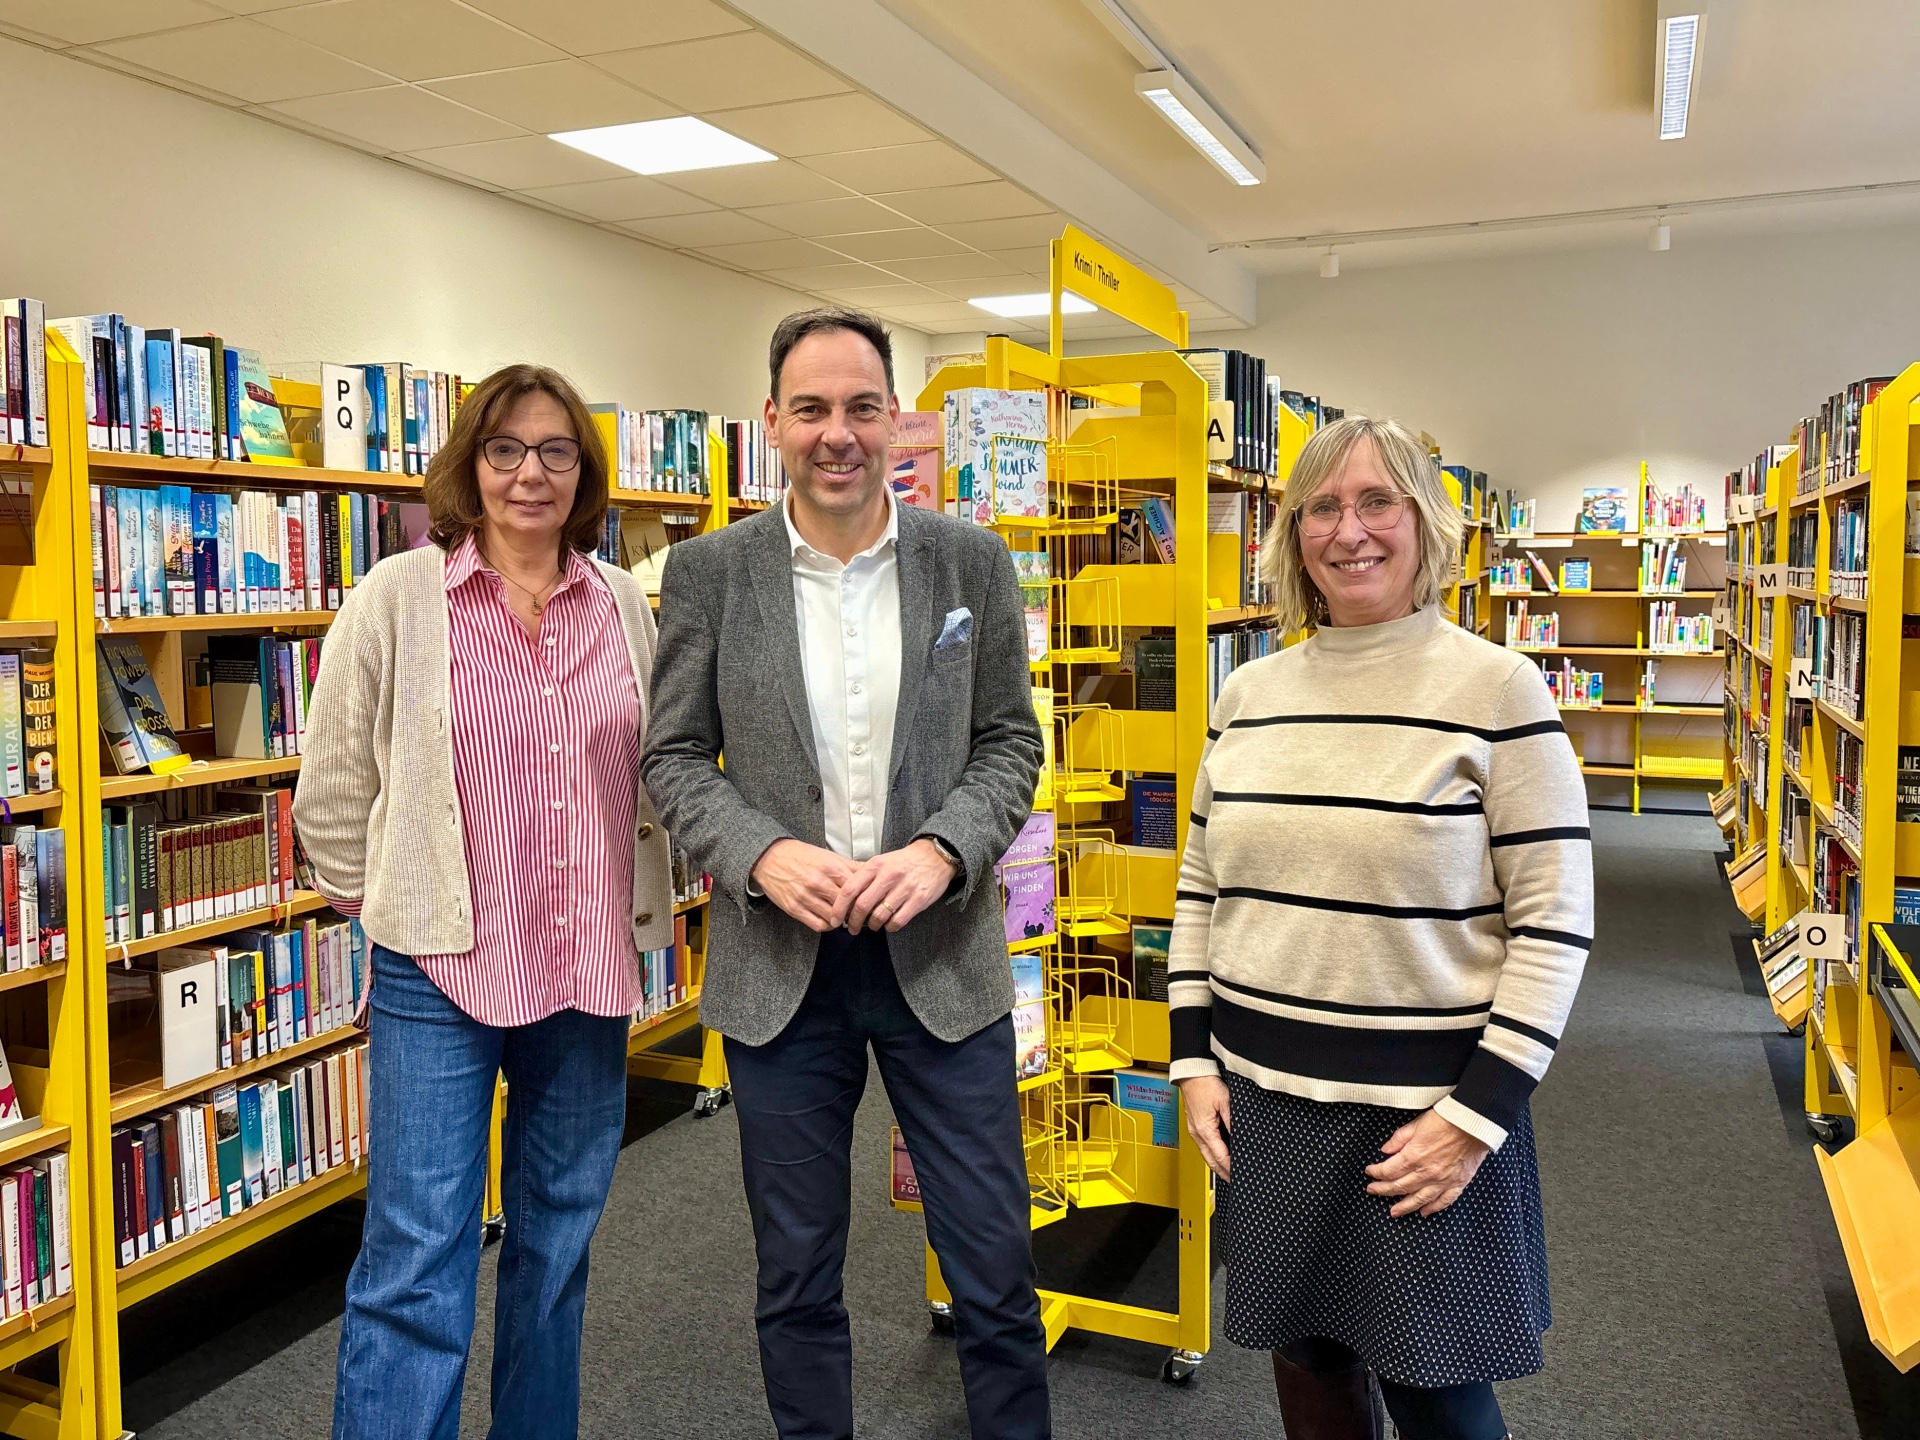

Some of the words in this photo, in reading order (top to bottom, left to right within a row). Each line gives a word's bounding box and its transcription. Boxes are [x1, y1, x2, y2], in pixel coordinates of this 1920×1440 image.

[1074, 251, 1092, 270] Krimi
[1098, 264, 1120, 292] Thriller
[337, 379, 350, 402] P
[240, 419, 270, 430] Schwebe
[336, 406, 353, 430] Q
[906, 420, 928, 431] kleine
[990, 413, 1023, 423] Katharina
[1005, 420, 1028, 432] Herzog
[258, 428, 286, 441] bahnen
[1208, 418, 1226, 442] A
[992, 430, 1040, 454] TRÄUME
[1002, 450, 1014, 458] im
[980, 452, 1040, 476] SOMMER-
[994, 475, 1025, 490] wind
[330, 500, 338, 531] EUROPA
[1738, 504, 1748, 516] L
[1148, 505, 1166, 536] AICHNER
[170, 522, 179, 545] Stille
[128, 546, 137, 569] Pauly
[204, 551, 212, 572] Pauly
[222, 548, 230, 568] Pauly
[1491, 552, 1500, 562] H
[332, 560, 340, 587] GRAND
[1759, 573, 1777, 588] M
[1026, 618, 1044, 626] NUSA
[1716, 612, 1724, 624] J
[105, 644, 143, 660] RICHARD
[114, 664, 150, 678] POWERS
[1798, 669, 1812, 687] N
[32, 682, 51, 699] DER
[26, 698, 55, 715] STICH
[134, 696, 156, 712] DAS
[3, 681, 19, 766] URAKAMI
[34, 716, 52, 731] DER
[135, 714, 172, 734] GROSSE
[29, 730, 56, 748] BIENE
[148, 738, 174, 754] SPIEL
[1903, 756, 1920, 770] NE
[1897, 794, 1920, 804] WUND
[1006, 844, 1038, 856] ORGEN
[140, 862, 148, 890] ANNIE
[1003, 872, 1020, 882] WIR
[1021, 870, 1038, 880] UNS
[1014, 882, 1044, 894] FINDEN
[1894, 906, 1920, 916] WOLF
[1900, 914, 1920, 924] TAL
[1806, 926, 1827, 946] O
[180, 981, 198, 1008] R
[1126, 1084, 1172, 1096] Wildschweine
[1127, 1092, 1152, 1102] fressen
[268, 1098, 277, 1163] PFAUENSOMMER
